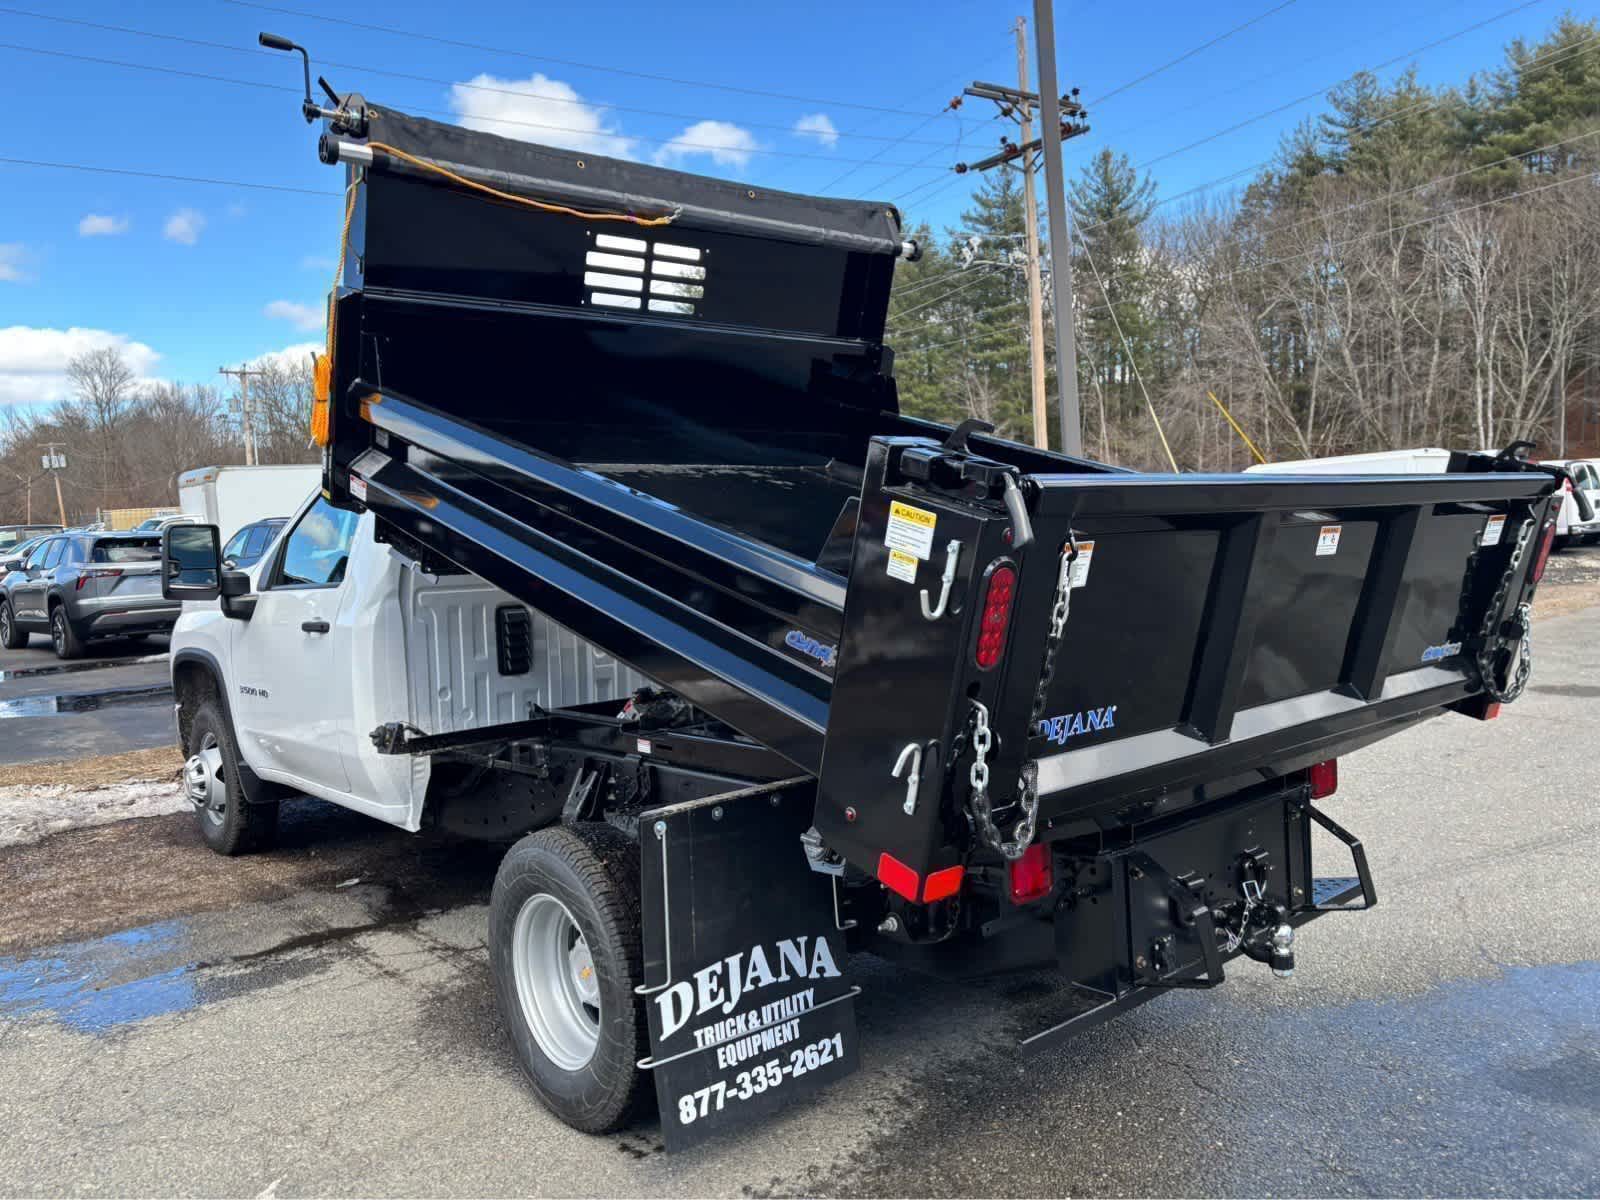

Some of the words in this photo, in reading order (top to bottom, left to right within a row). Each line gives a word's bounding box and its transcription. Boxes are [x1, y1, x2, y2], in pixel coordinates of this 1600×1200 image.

[901, 508, 931, 524] CAUTION
[258, 688, 269, 698] HD
[654, 936, 842, 1042] DEJANA
[693, 1013, 747, 1049] TRUCK
[748, 1010, 761, 1030] &
[761, 987, 814, 1026] UTILITY
[717, 1018, 800, 1070] EQUIPMENT
[678, 1033, 844, 1125] 877-335-2621
